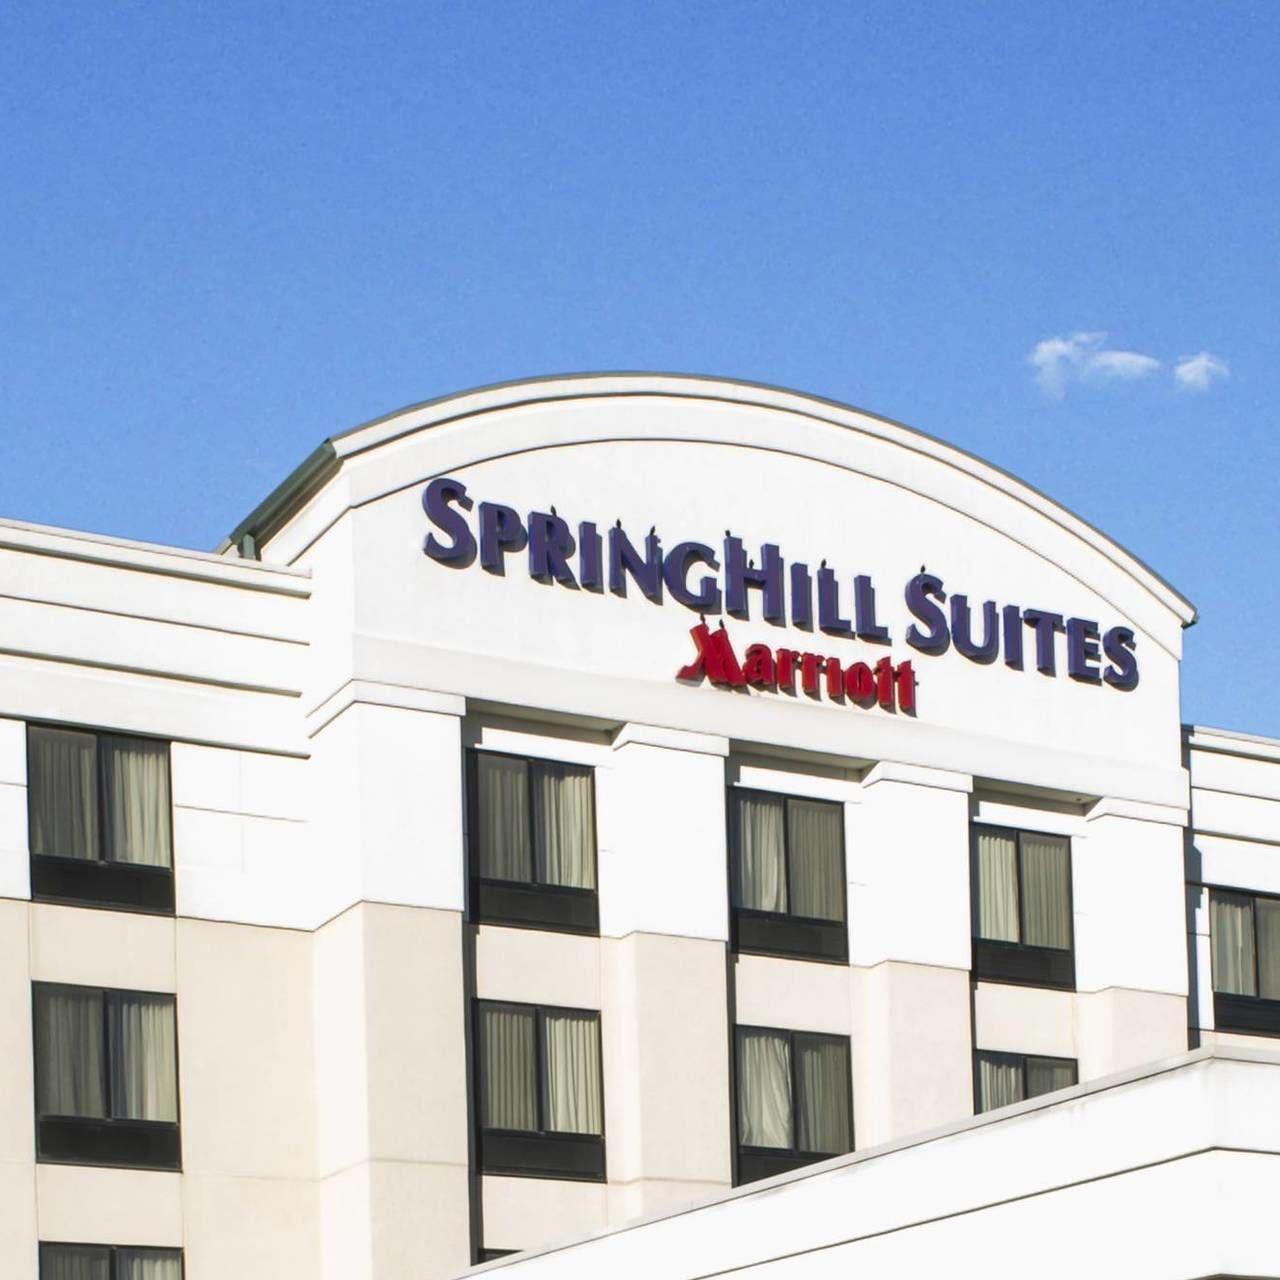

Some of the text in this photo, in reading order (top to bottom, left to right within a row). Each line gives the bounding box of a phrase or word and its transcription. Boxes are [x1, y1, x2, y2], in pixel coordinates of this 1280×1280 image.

[422, 477, 1139, 691] SPRINGHILL SUITES
[675, 623, 917, 716] Marriott
